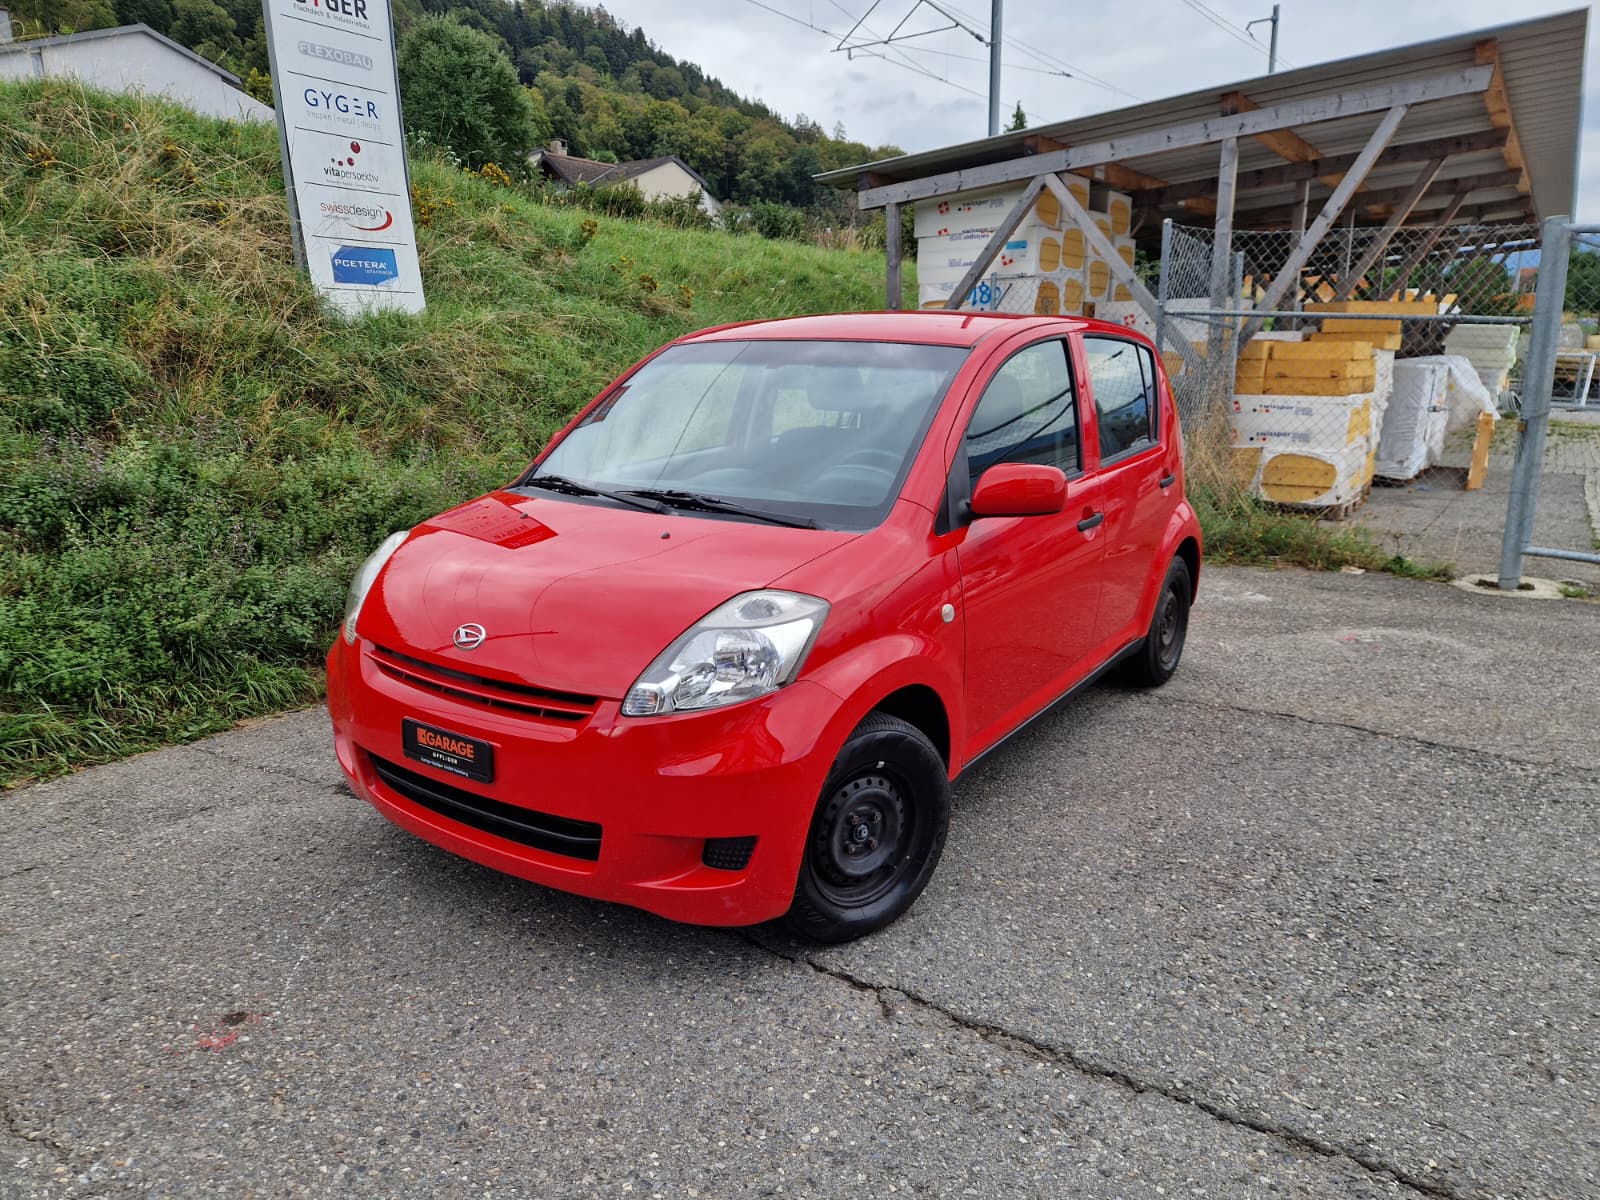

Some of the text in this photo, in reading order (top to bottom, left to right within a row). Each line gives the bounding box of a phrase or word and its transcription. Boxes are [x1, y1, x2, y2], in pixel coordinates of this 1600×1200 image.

[295, 0, 368, 20] GER
[299, 42, 372, 68] FLEXOBAU
[304, 88, 379, 119] GYGER
[323, 166, 379, 182] vitaperspektiv
[320, 201, 382, 219] swissdesign
[427, 732, 475, 758] GARAGE
